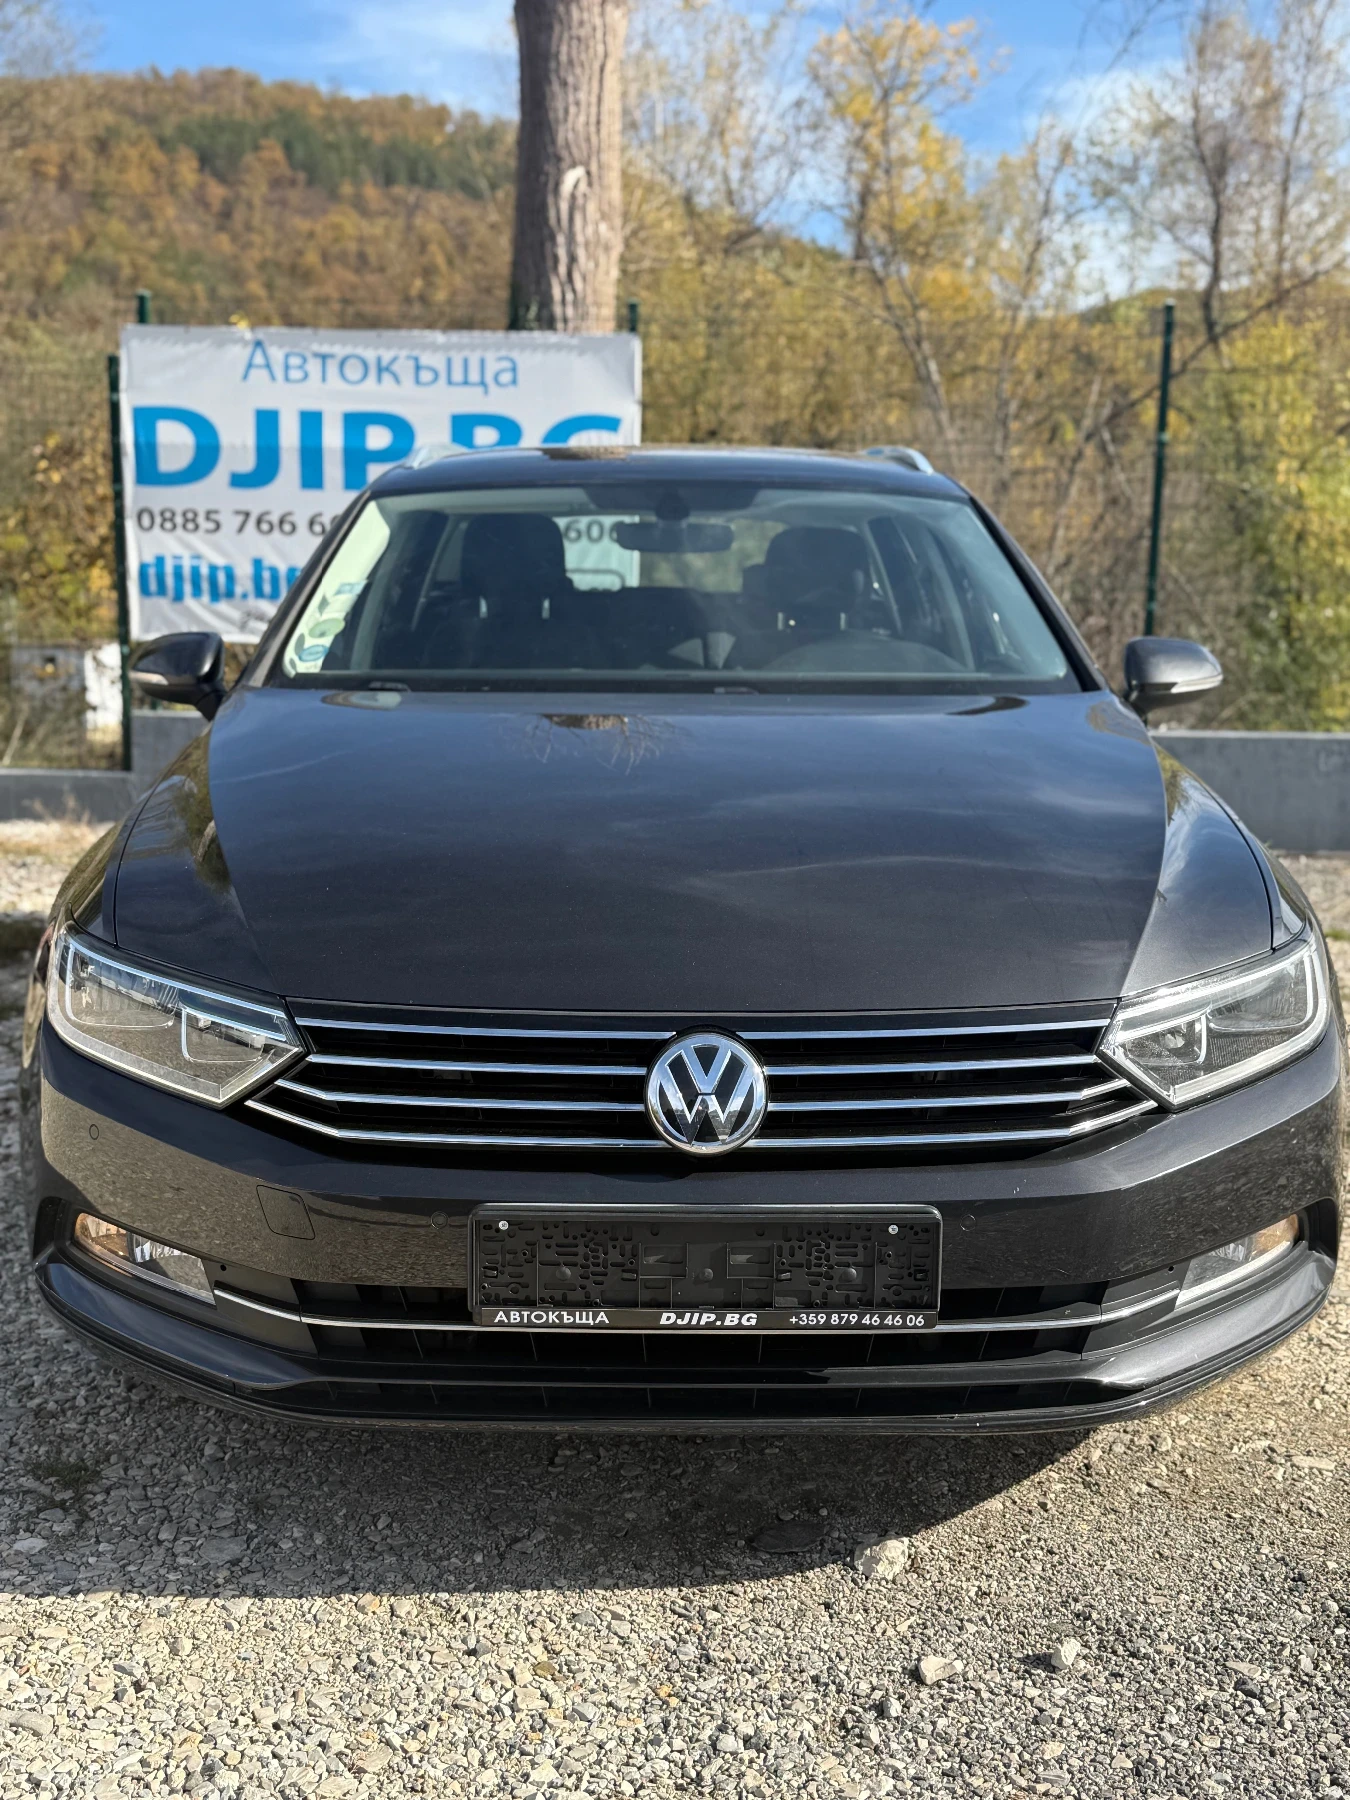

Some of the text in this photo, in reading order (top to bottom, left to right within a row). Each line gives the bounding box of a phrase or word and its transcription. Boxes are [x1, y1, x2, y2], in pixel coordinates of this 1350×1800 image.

[242, 339, 519, 395] Автокъща
[136, 507, 221, 534] 0885
[233, 510, 297, 536] 766
[494, 1310, 610, 1325] АВТОКЪЩА
[659, 1312, 758, 1325] DJIP.BG
[789, 1313, 925, 1327] +359 879 46 46 06
